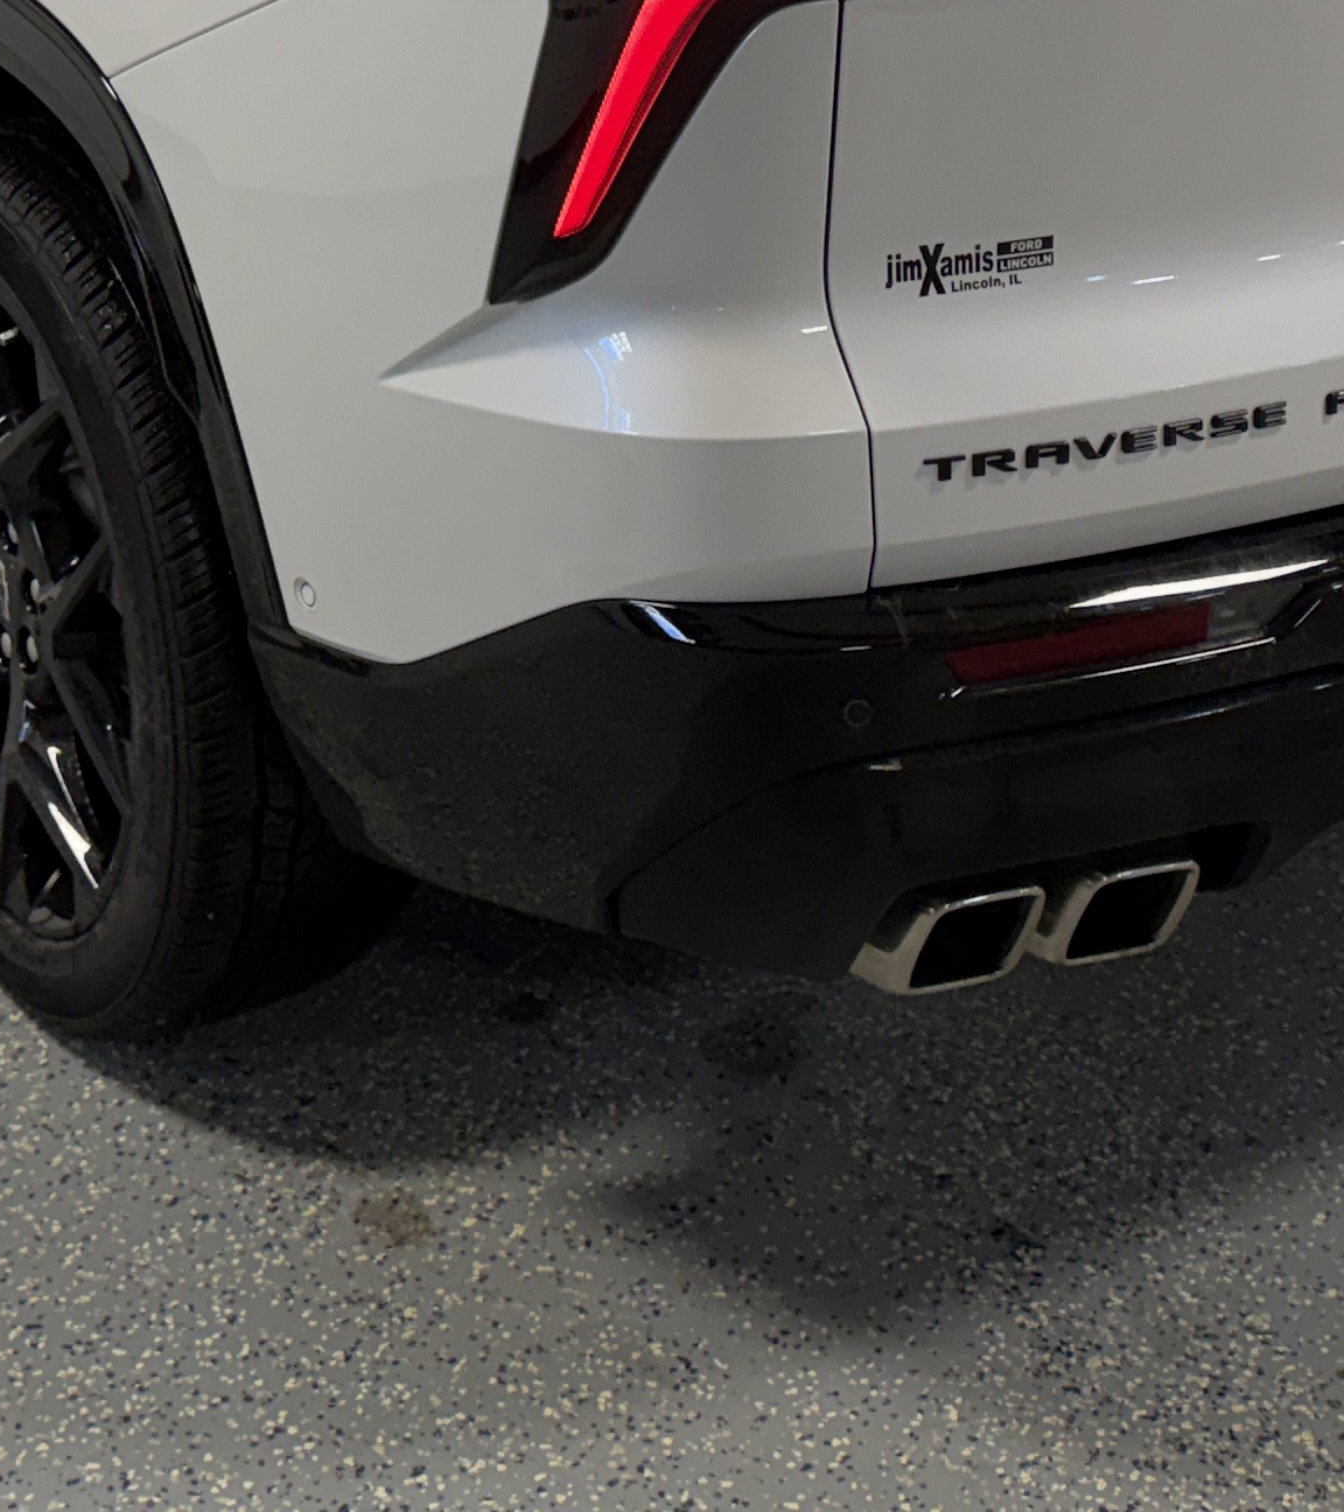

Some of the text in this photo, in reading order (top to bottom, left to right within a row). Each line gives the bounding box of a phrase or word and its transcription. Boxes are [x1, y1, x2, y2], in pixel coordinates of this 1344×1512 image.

[1010, 238, 1043, 254] FORD
[885, 243, 994, 298] jimXamis
[998, 253, 1053, 271] LINCOLN
[951, 274, 1023, 293] Lincoln, IL
[923, 399, 1288, 483] TRAVERSE
